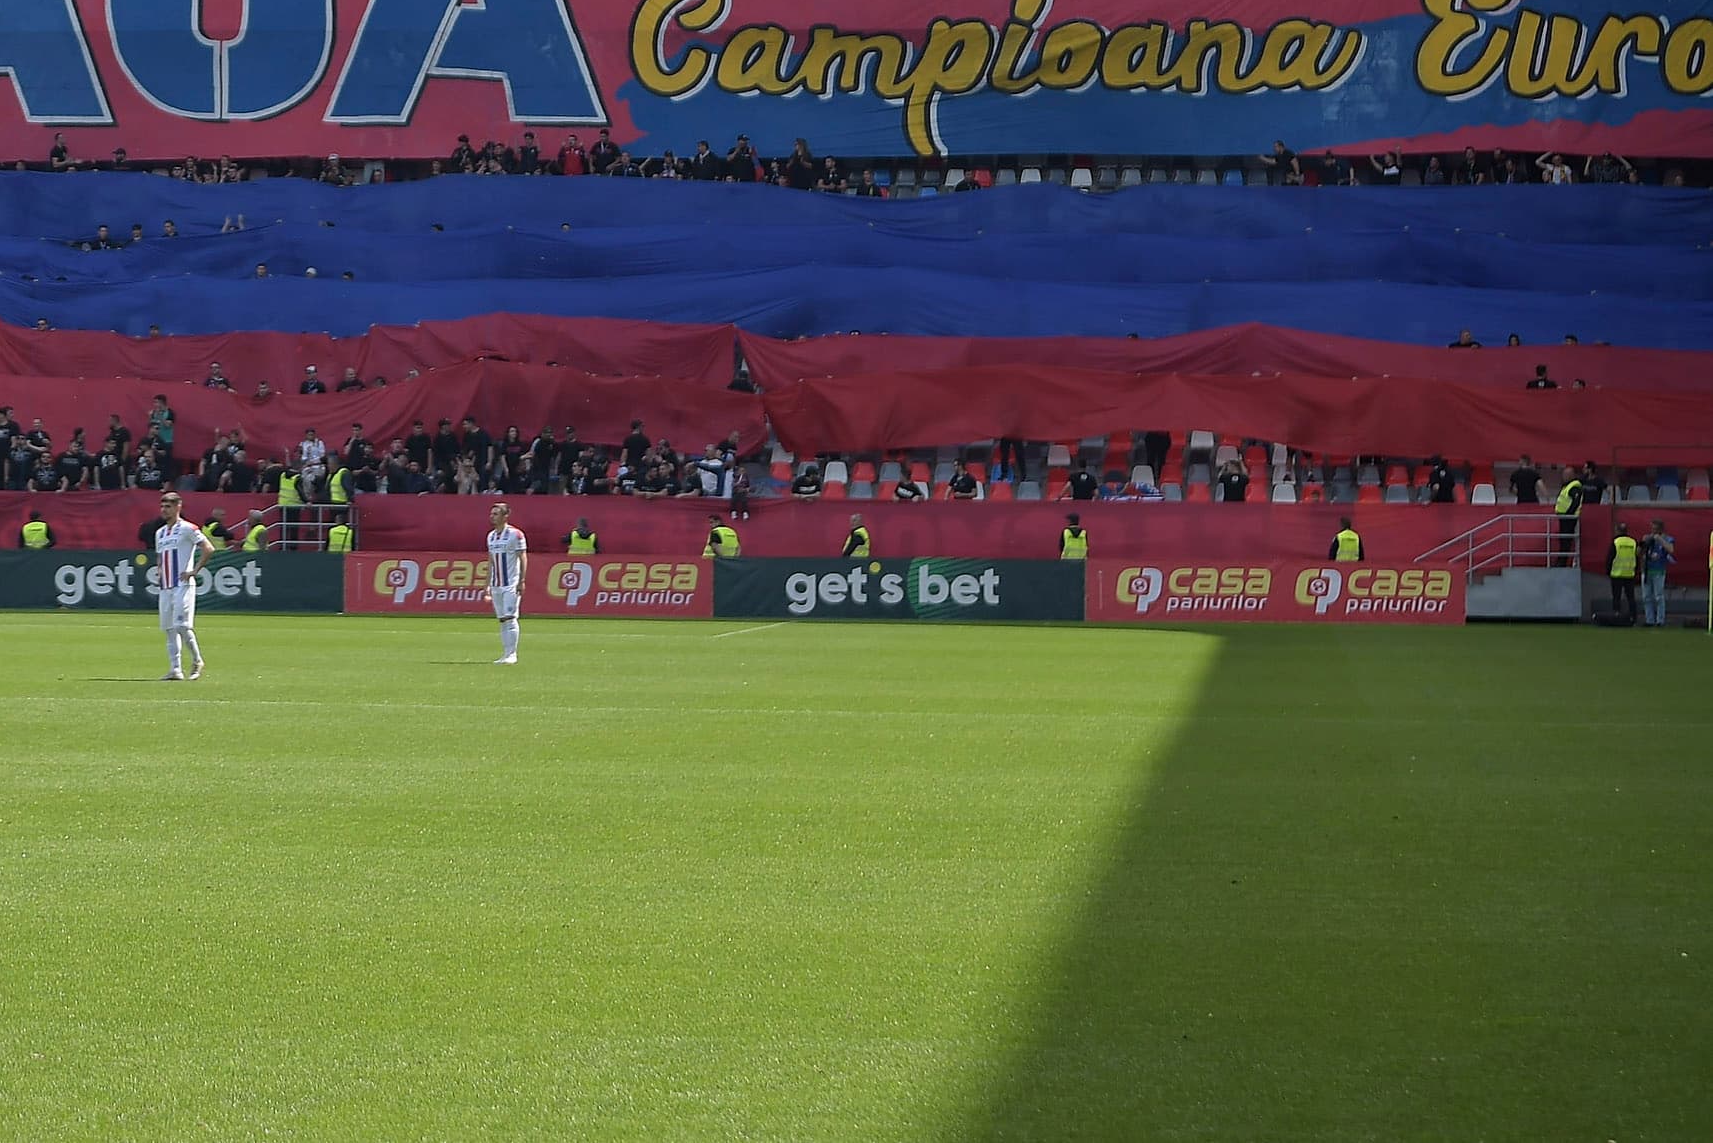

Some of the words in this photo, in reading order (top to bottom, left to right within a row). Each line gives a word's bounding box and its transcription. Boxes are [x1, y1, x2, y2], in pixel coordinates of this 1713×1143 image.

[424, 560, 489, 587] cas
[597, 562, 699, 590] casa
[918, 564, 1000, 604] bet
[1168, 567, 1272, 594] casa
[1347, 569, 1452, 597] casa
[595, 589, 695, 606] pariurilor
[1166, 594, 1268, 612] pariurilor
[1345, 596, 1447, 614] pariurilor
